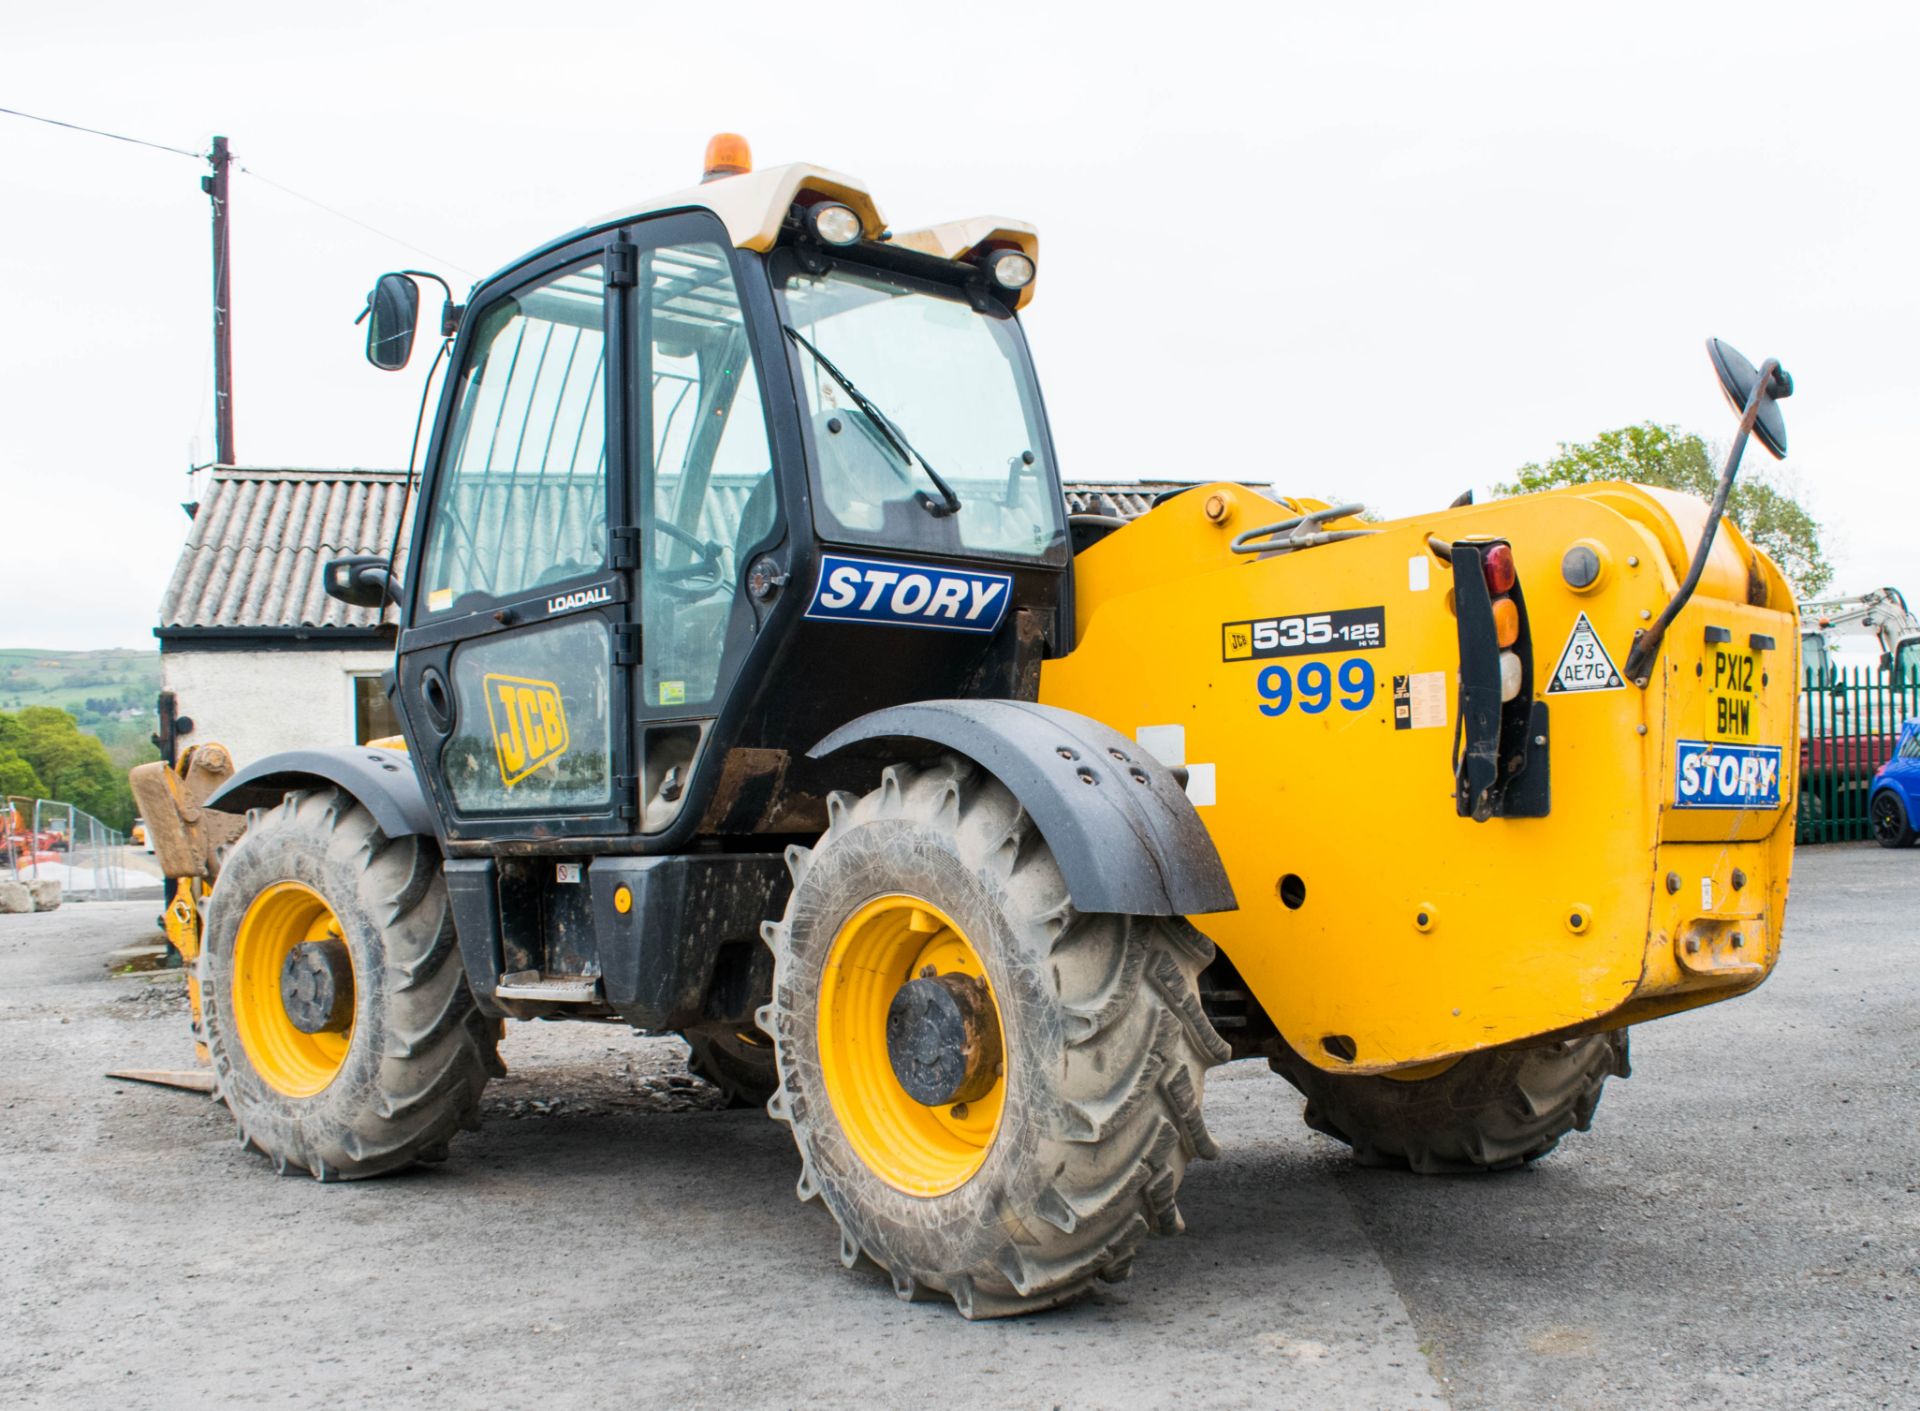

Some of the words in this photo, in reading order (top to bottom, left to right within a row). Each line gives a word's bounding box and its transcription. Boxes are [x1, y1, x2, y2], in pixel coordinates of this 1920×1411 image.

[548, 587, 611, 613] LOADALL
[820, 566, 1005, 620] STORY
[1565, 663, 1605, 681] AE7G
[1575, 644, 1594, 661] 93
[1715, 652, 1753, 692] PX12
[1257, 658, 1375, 717] 999
[498, 685, 563, 773] JCB
[1717, 697, 1750, 735] BHW
[1680, 753, 1777, 796] STORY
